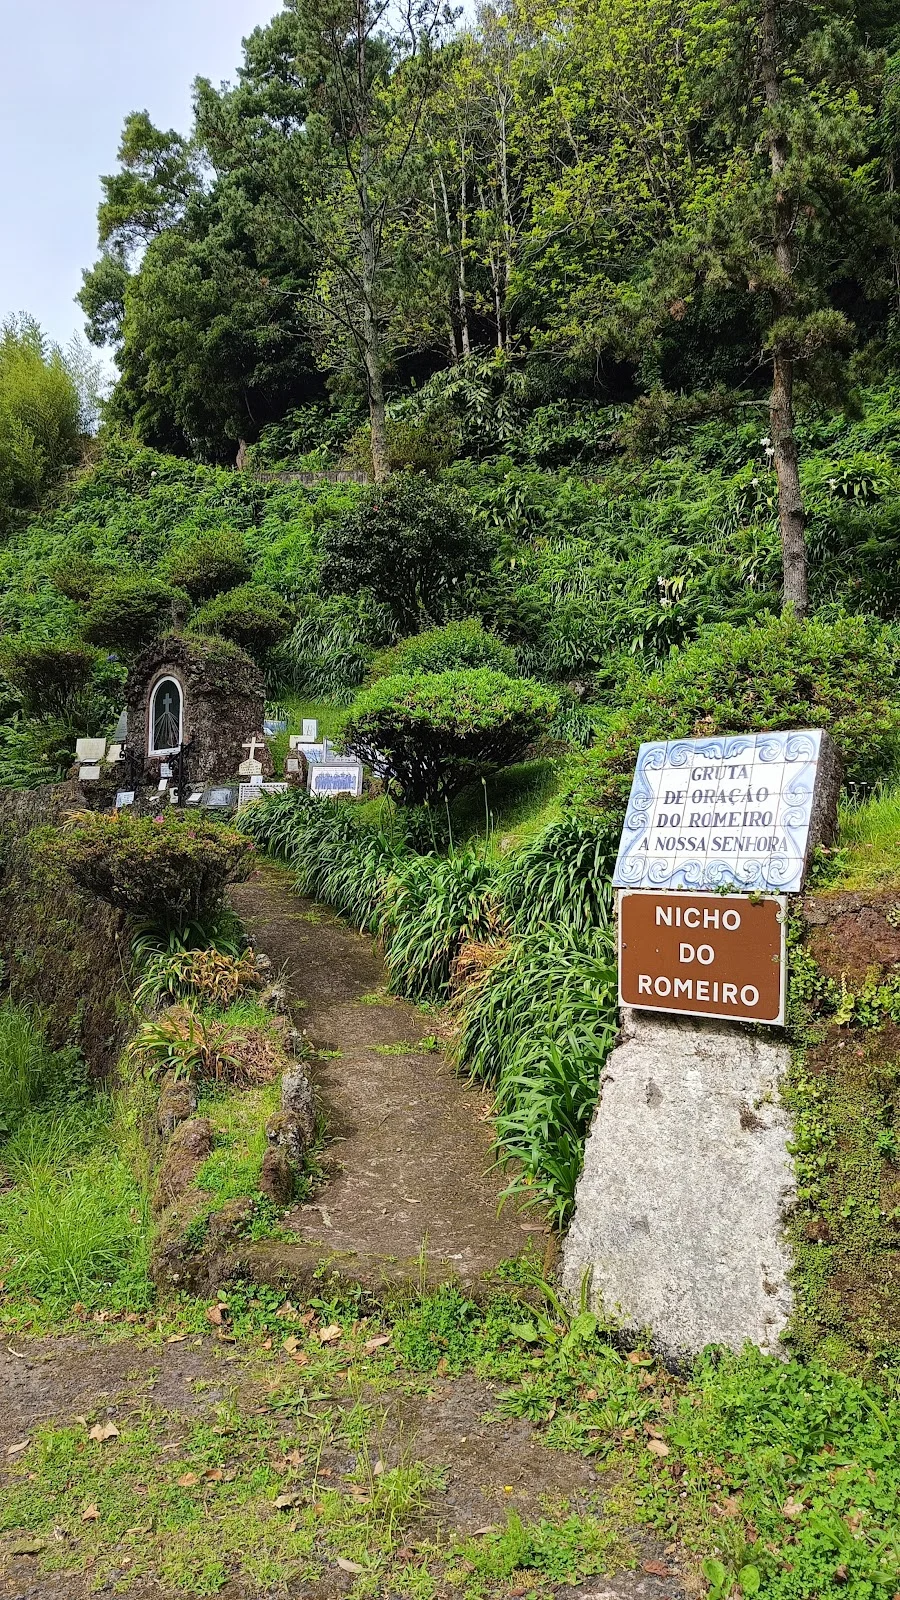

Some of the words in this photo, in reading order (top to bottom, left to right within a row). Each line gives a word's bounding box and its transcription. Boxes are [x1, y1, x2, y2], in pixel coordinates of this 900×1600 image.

[692, 765, 748, 781] GRUTA
[664, 790, 686, 805] DE
[657, 813, 681, 828] DO
[689, 811, 773, 828] ROMEIRO
[638, 837, 649, 851] A
[655, 836, 706, 851] NOSSA
[711, 836, 788, 852] SENHORA
[655, 905, 741, 931] NICHO
[679, 943, 715, 965] DO
[638, 974, 760, 1007] ROMEIRO
